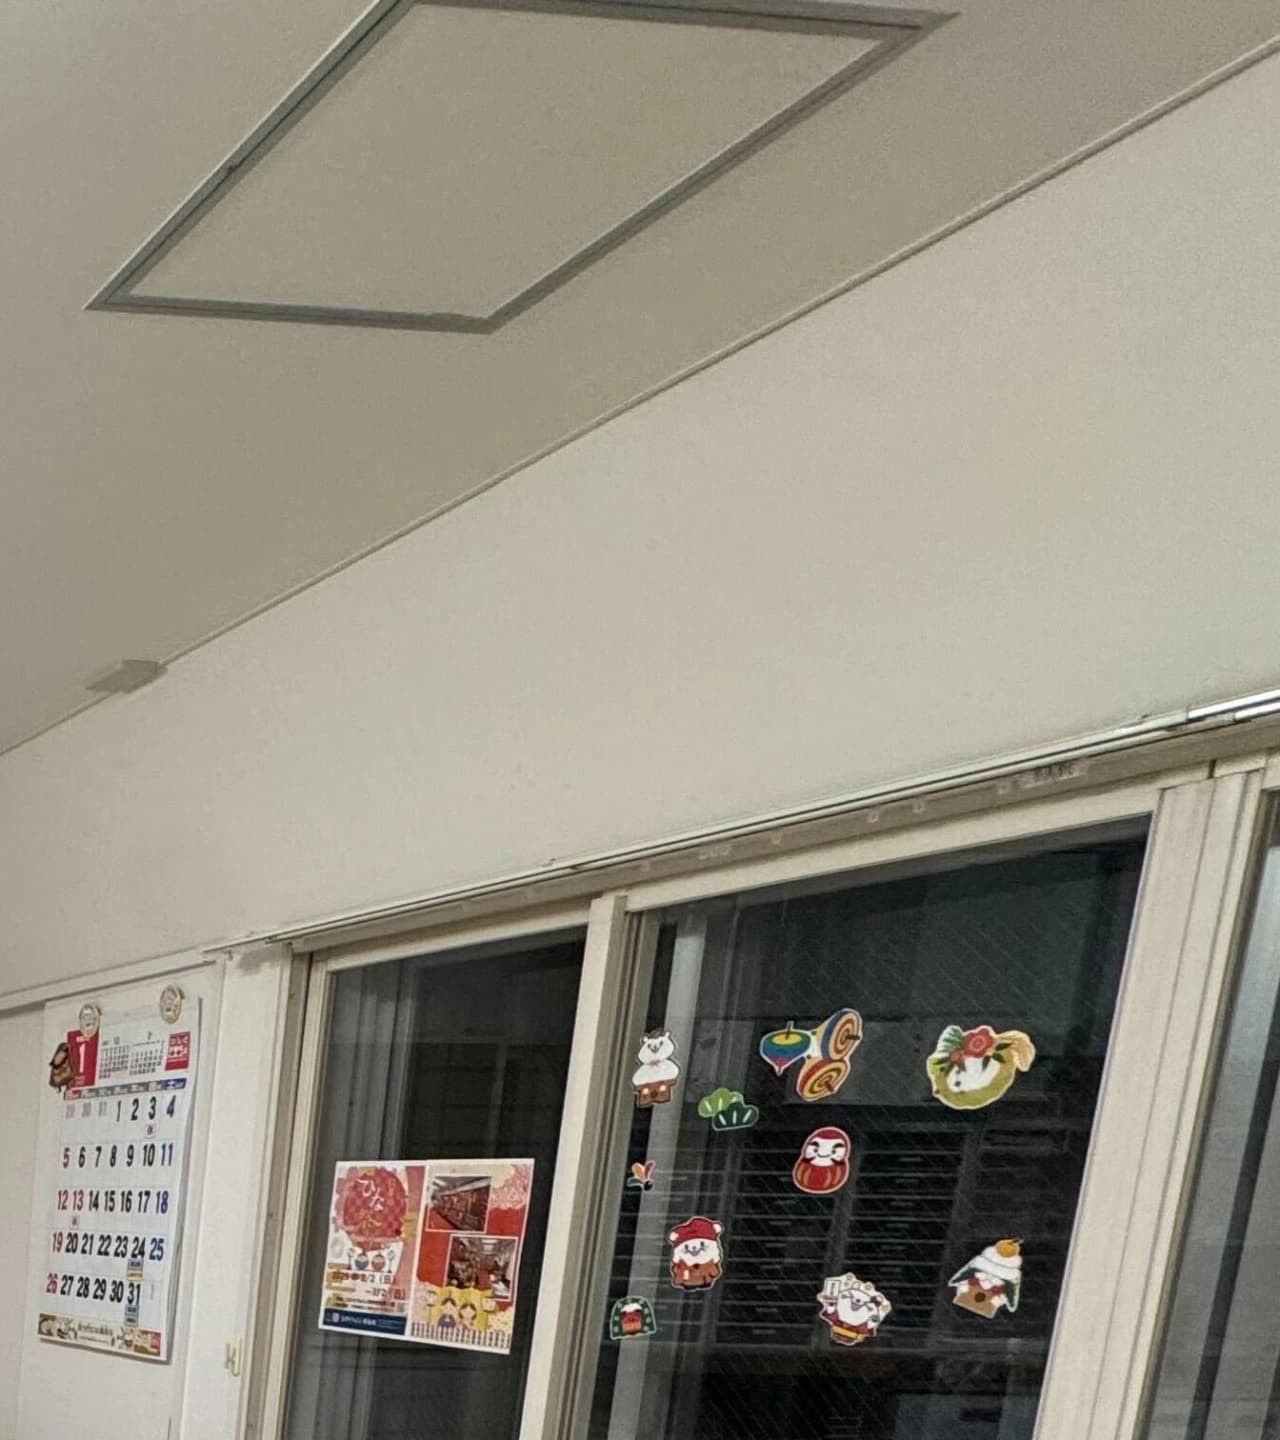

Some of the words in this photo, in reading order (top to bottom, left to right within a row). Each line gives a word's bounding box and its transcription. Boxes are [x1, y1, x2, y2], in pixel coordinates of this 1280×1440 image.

[79, 1042, 86, 1073] 1
[131, 1098, 139, 1120] 2
[148, 1096, 156, 1120] 3
[166, 1095, 176, 1118] 4
[63, 1147, 70, 1168] 5
[79, 1146, 86, 1168] 6
[95, 1146, 102, 1168] 7
[110, 1145, 117, 1167] 8
[126, 1144, 134, 1167] 9
[143, 1143, 155, 1166] 10
[161, 1143, 173, 1166] 11
[57, 1189, 69, 1210] 12
[72, 1190, 84, 1211] 13
[89, 1190, 99, 1211] 14
[104, 1190, 116, 1212] 15
[120, 1190, 133, 1213] 16
[138, 1190, 151, 1213] 17
[156, 1190, 169, 1214] 18
[52, 1232, 63, 1253] 19
[65, 1232, 78, 1254] 20
[81, 1233, 94, 1255] 21
[97, 1234, 111, 1256] 22
[114, 1235, 128, 1258] 23
[131, 1236, 146, 1259] 24
[149, 1238, 165, 1261] 25
[46, 1272, 58, 1294] 26
[60, 1275, 74, 1296] 27
[76, 1276, 90, 1298] 28
[92, 1278, 107, 1300] 29
[109, 1280, 124, 1303] 30
[127, 1282, 141, 1305] 31
